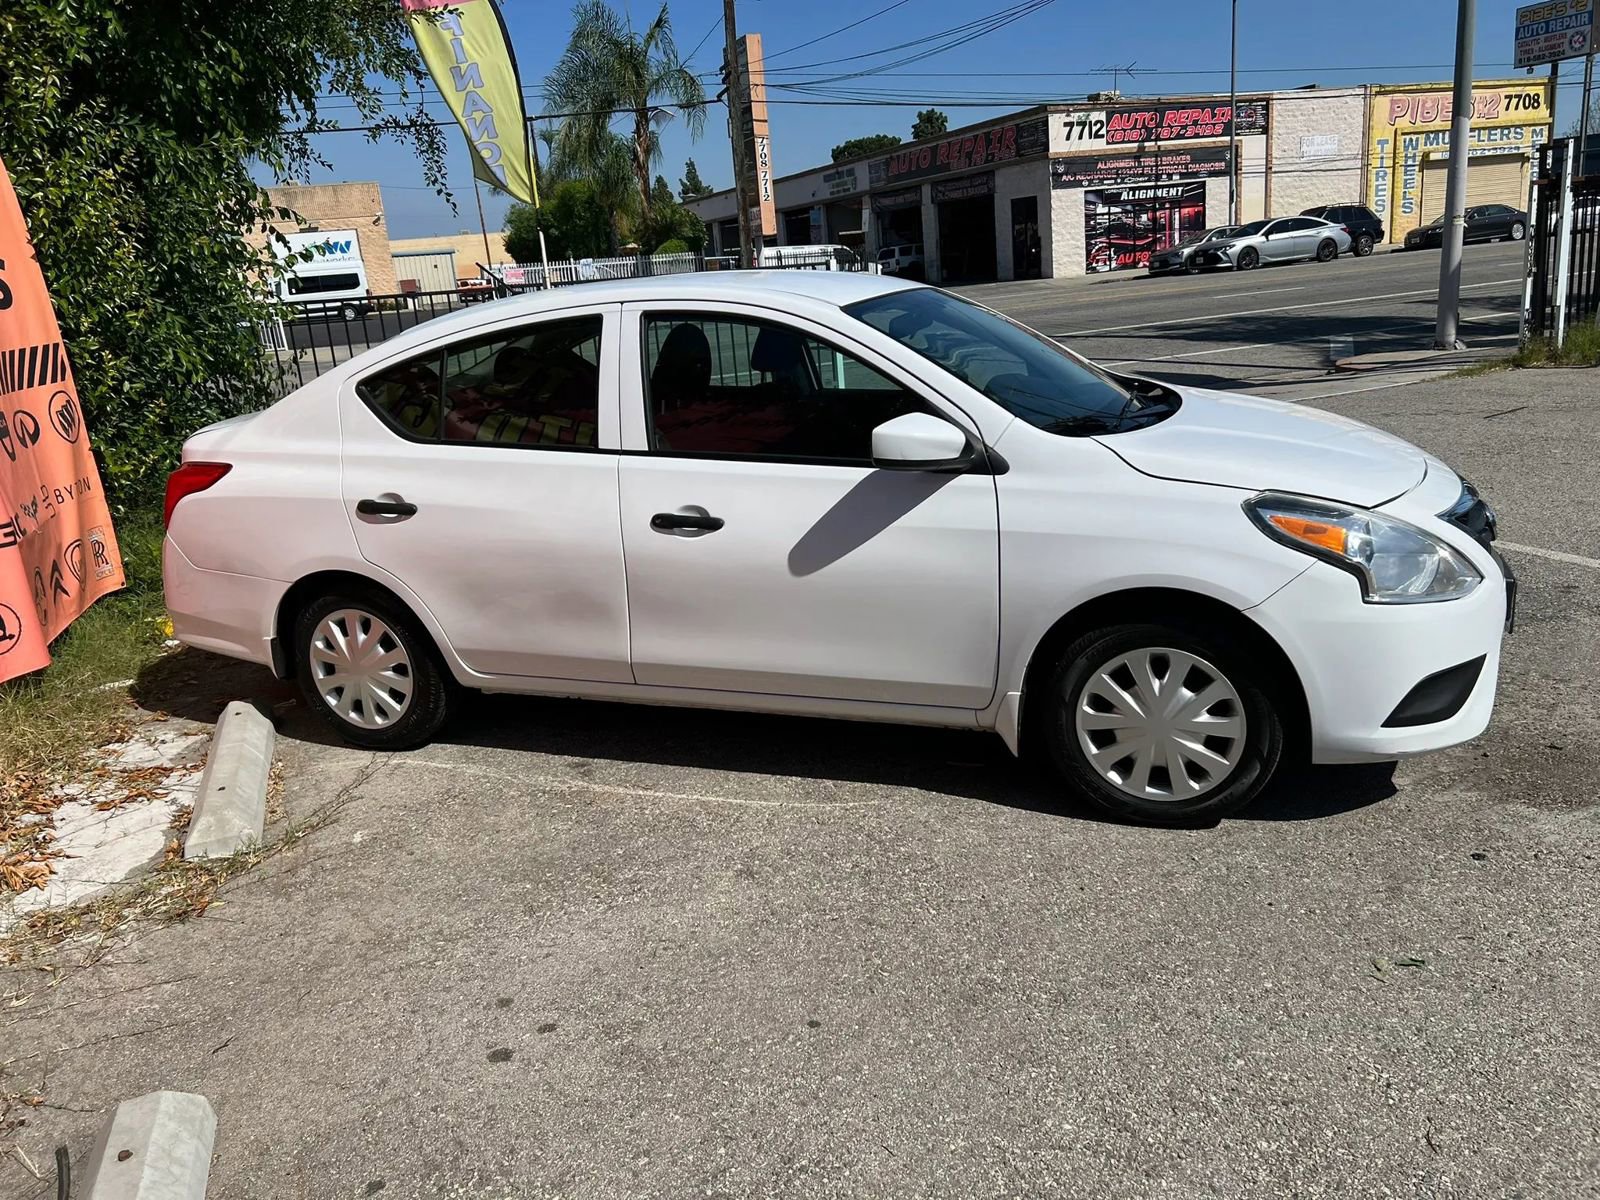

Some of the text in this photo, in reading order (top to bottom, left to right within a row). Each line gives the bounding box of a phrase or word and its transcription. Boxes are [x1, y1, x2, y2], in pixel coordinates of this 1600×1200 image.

[1518, 13, 1589, 40] AUTO REPAIR
[1504, 93, 1541, 112] 7708
[1063, 120, 1106, 141] 7712
[1107, 111, 1160, 130] AUTO
[1107, 130, 1147, 142] (818)
[1301, 137, 1316, 148] FOR
[758, 137, 768, 168] 7708
[888, 147, 932, 176] AUTO
[936, 125, 1017, 166] REPAIR
[1162, 154, 1191, 165] BRAKES
[1188, 161, 1226, 173] DIAGNOSIS
[1374, 139, 1389, 213] TIRES
[1402, 137, 1419, 214] WHEELS
[761, 171, 770, 202] 7712
[1120, 186, 1184, 201] ALIGNMENT
